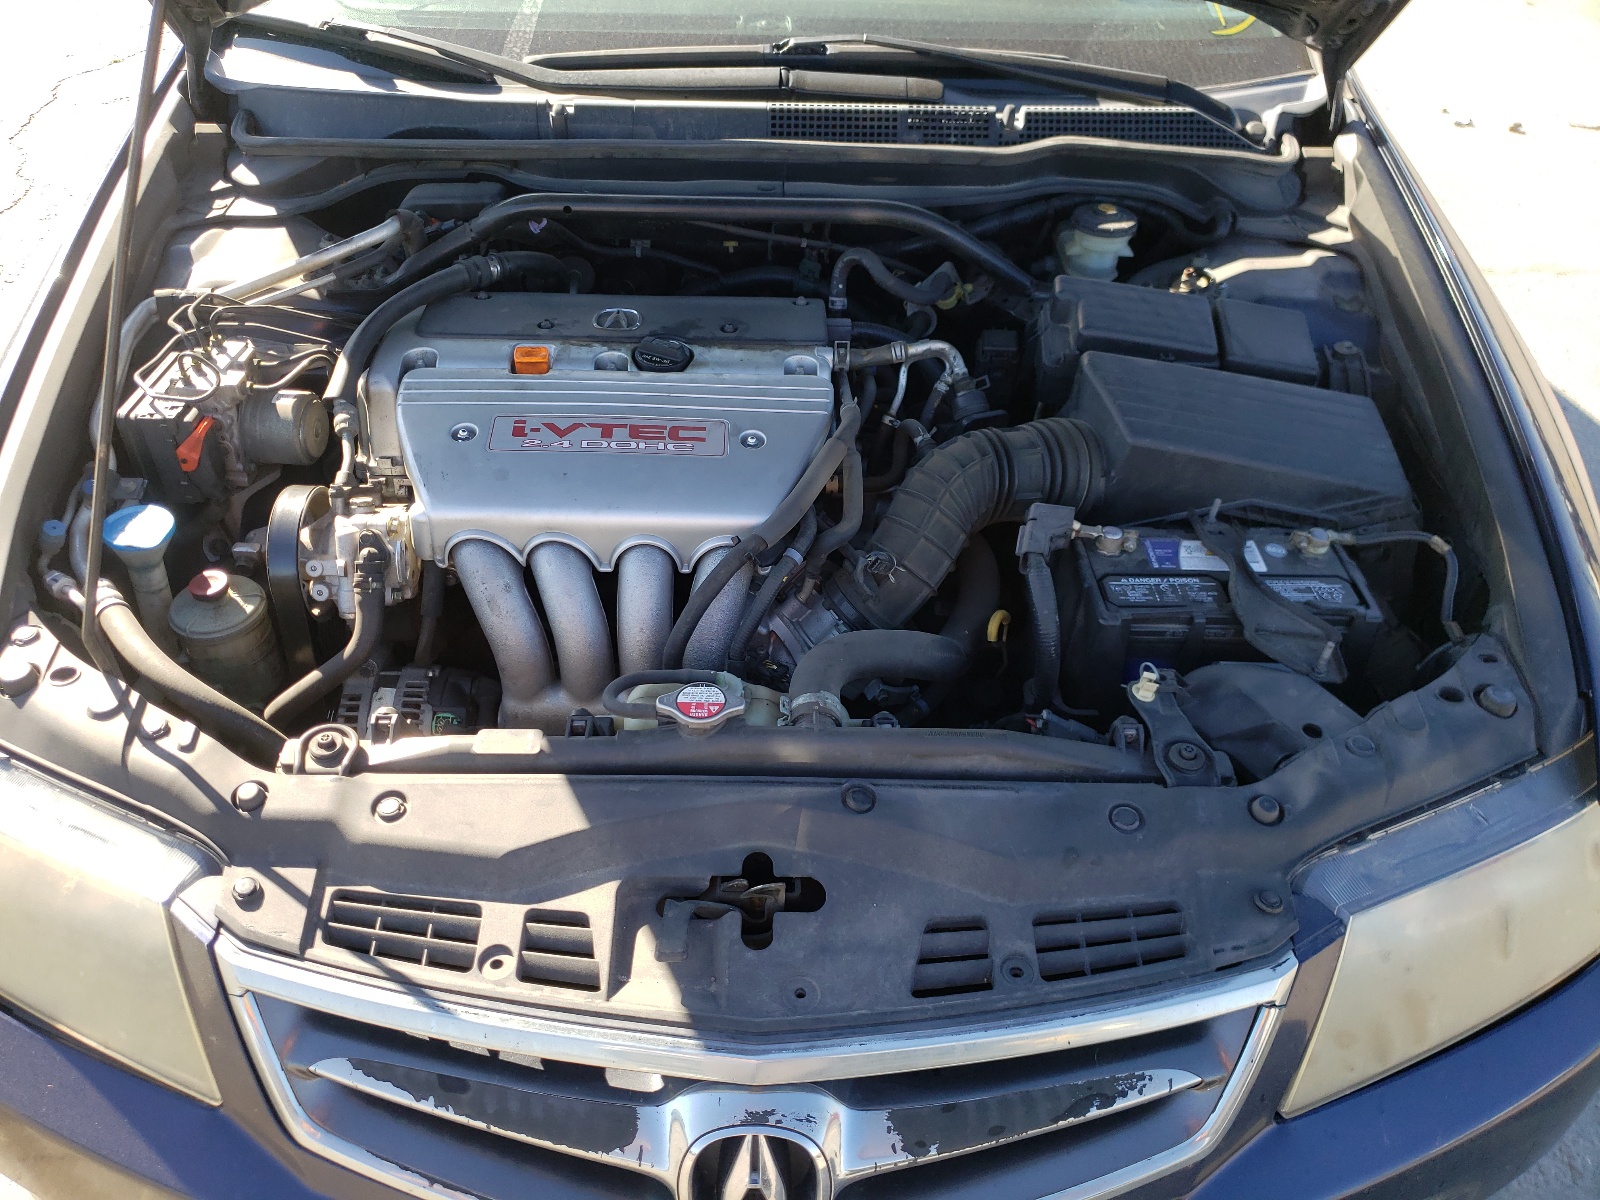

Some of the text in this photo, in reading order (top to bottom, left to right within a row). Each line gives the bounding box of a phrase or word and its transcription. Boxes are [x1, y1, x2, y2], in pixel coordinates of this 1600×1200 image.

[511, 419, 706, 442] i-VTEC
[520, 438, 694, 451] 2.4 DOHC
